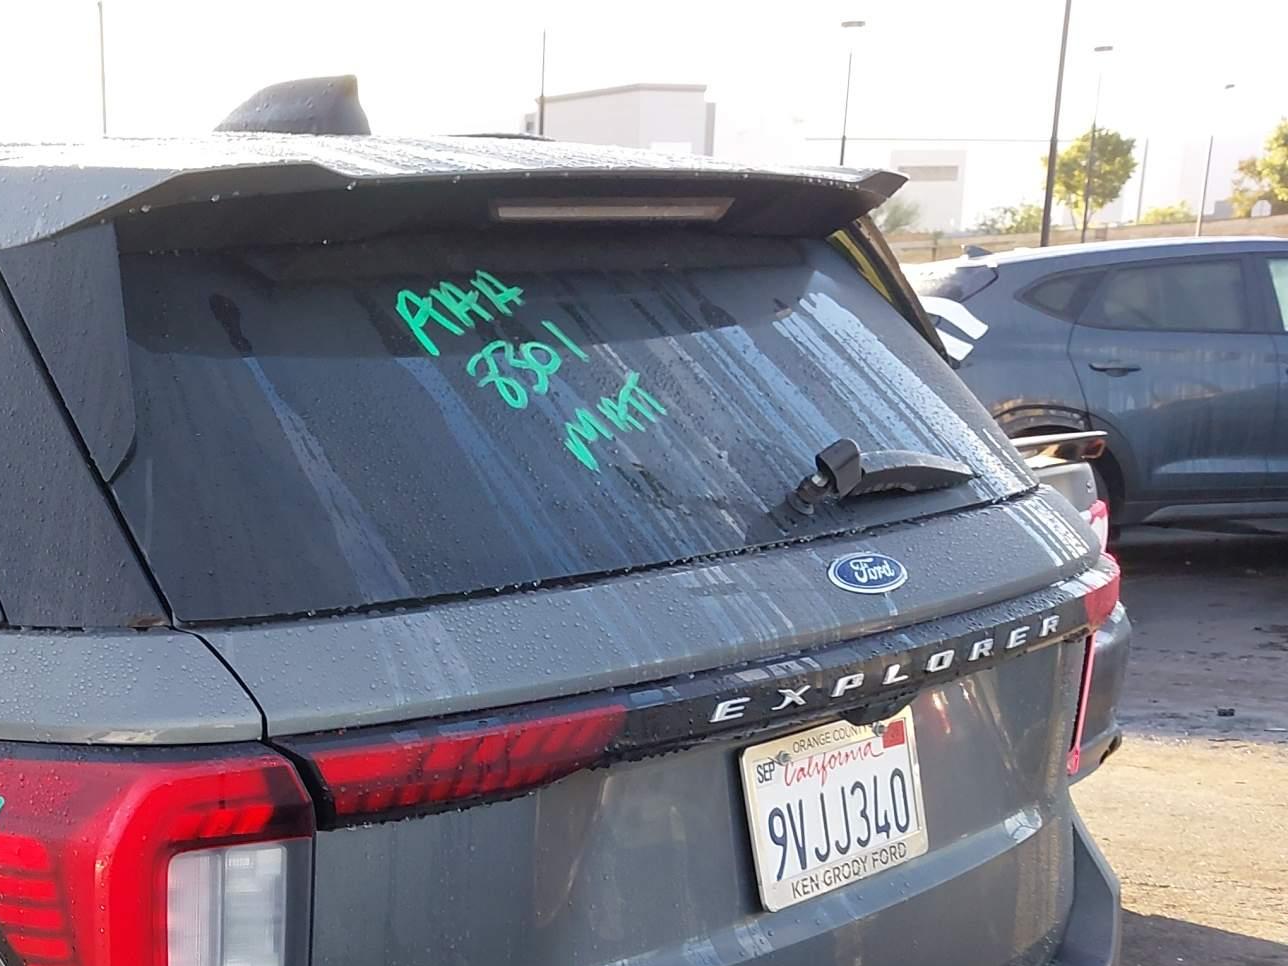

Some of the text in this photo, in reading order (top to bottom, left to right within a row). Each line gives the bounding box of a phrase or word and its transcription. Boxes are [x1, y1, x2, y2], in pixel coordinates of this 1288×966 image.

[850, 557, 896, 583] Ford
[710, 614, 1060, 724] EXPLORER
[783, 741, 885, 788] California
[793, 733, 832, 753] ORANGE
[756, 760, 776, 784] SEP
[768, 768, 910, 882] 9VJJ340
[791, 842, 908, 900] KEN GRODY FORD
